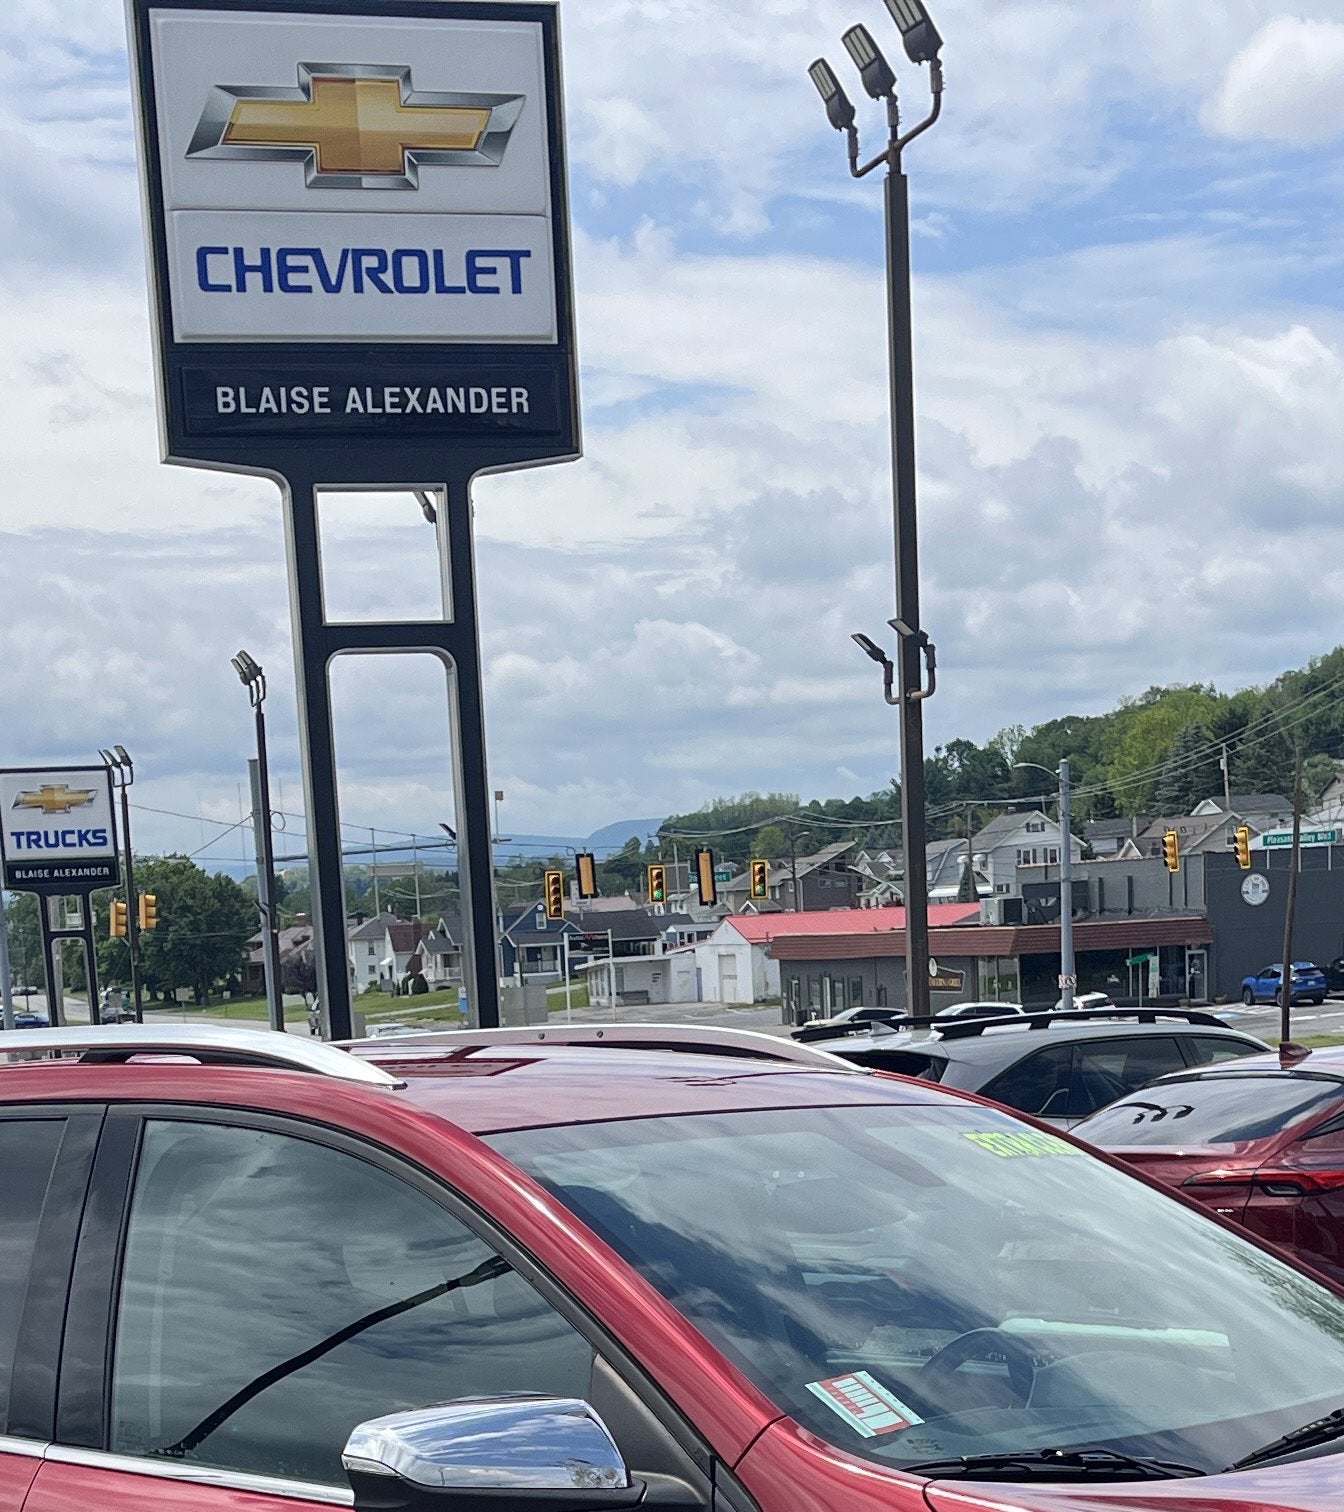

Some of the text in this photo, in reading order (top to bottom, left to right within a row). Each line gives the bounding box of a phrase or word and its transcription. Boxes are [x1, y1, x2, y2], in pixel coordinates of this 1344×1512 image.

[196, 246, 531, 294] CHEVROLET
[216, 386, 529, 414] BLAISE ALEXANDER
[10, 828, 108, 849] TRUCKS
[15, 867, 109, 879] BLAISE ALEXANDER
